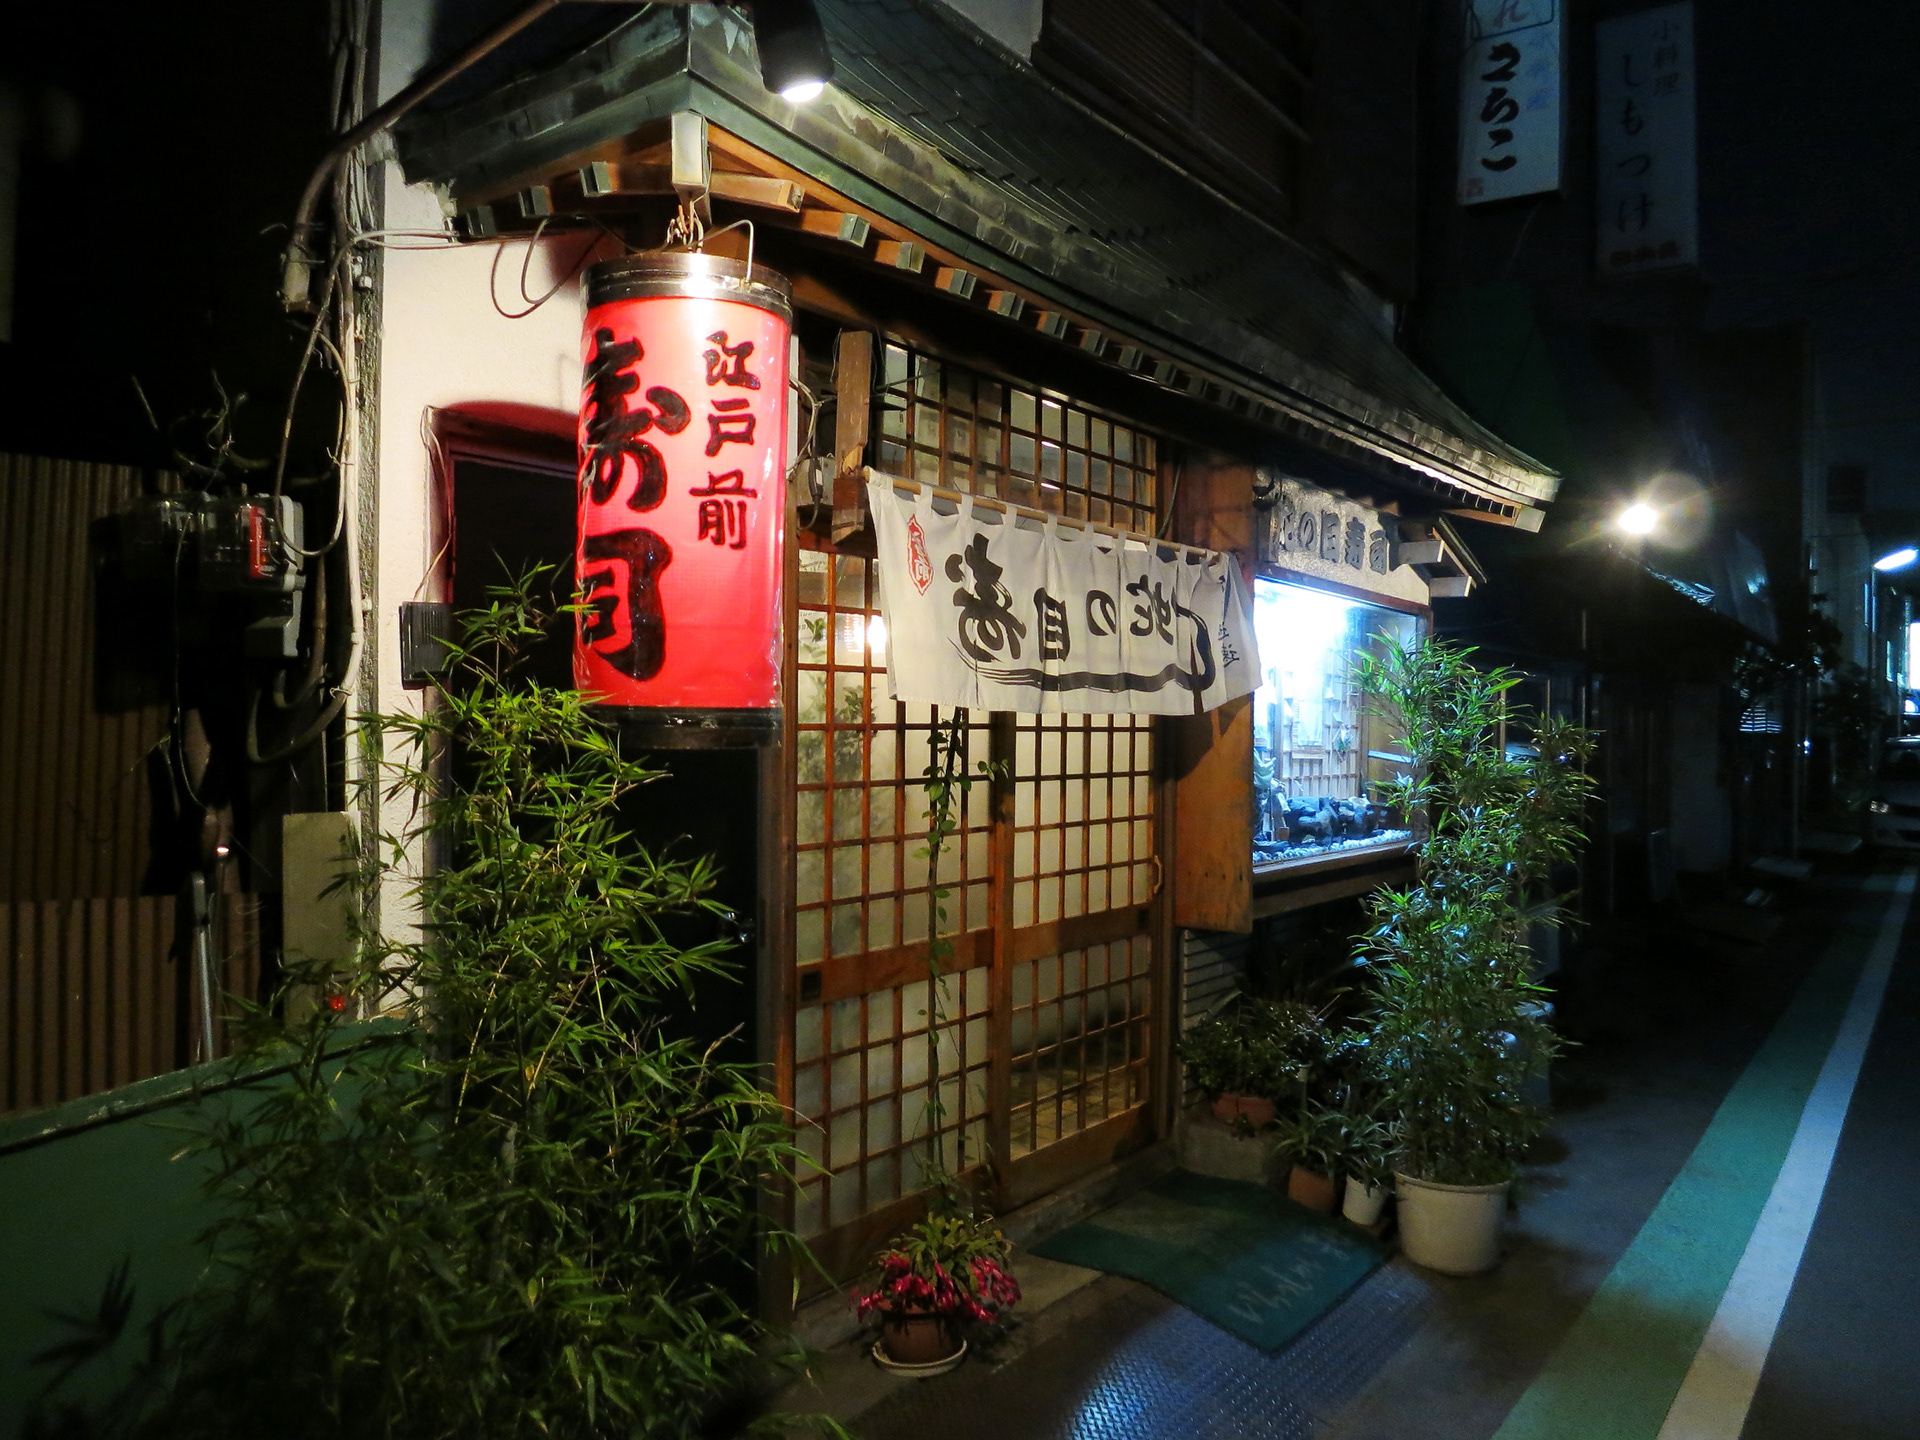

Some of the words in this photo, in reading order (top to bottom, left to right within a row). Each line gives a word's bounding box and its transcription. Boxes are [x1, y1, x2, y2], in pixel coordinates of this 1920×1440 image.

[1480, 42, 1521, 172] さちこ
[1616, 54, 1653, 233] しもつけ
[1653, 20, 1680, 96] 小料理
[581, 327, 691, 681] 寿司
[690, 330, 761, 549] 江戸前
